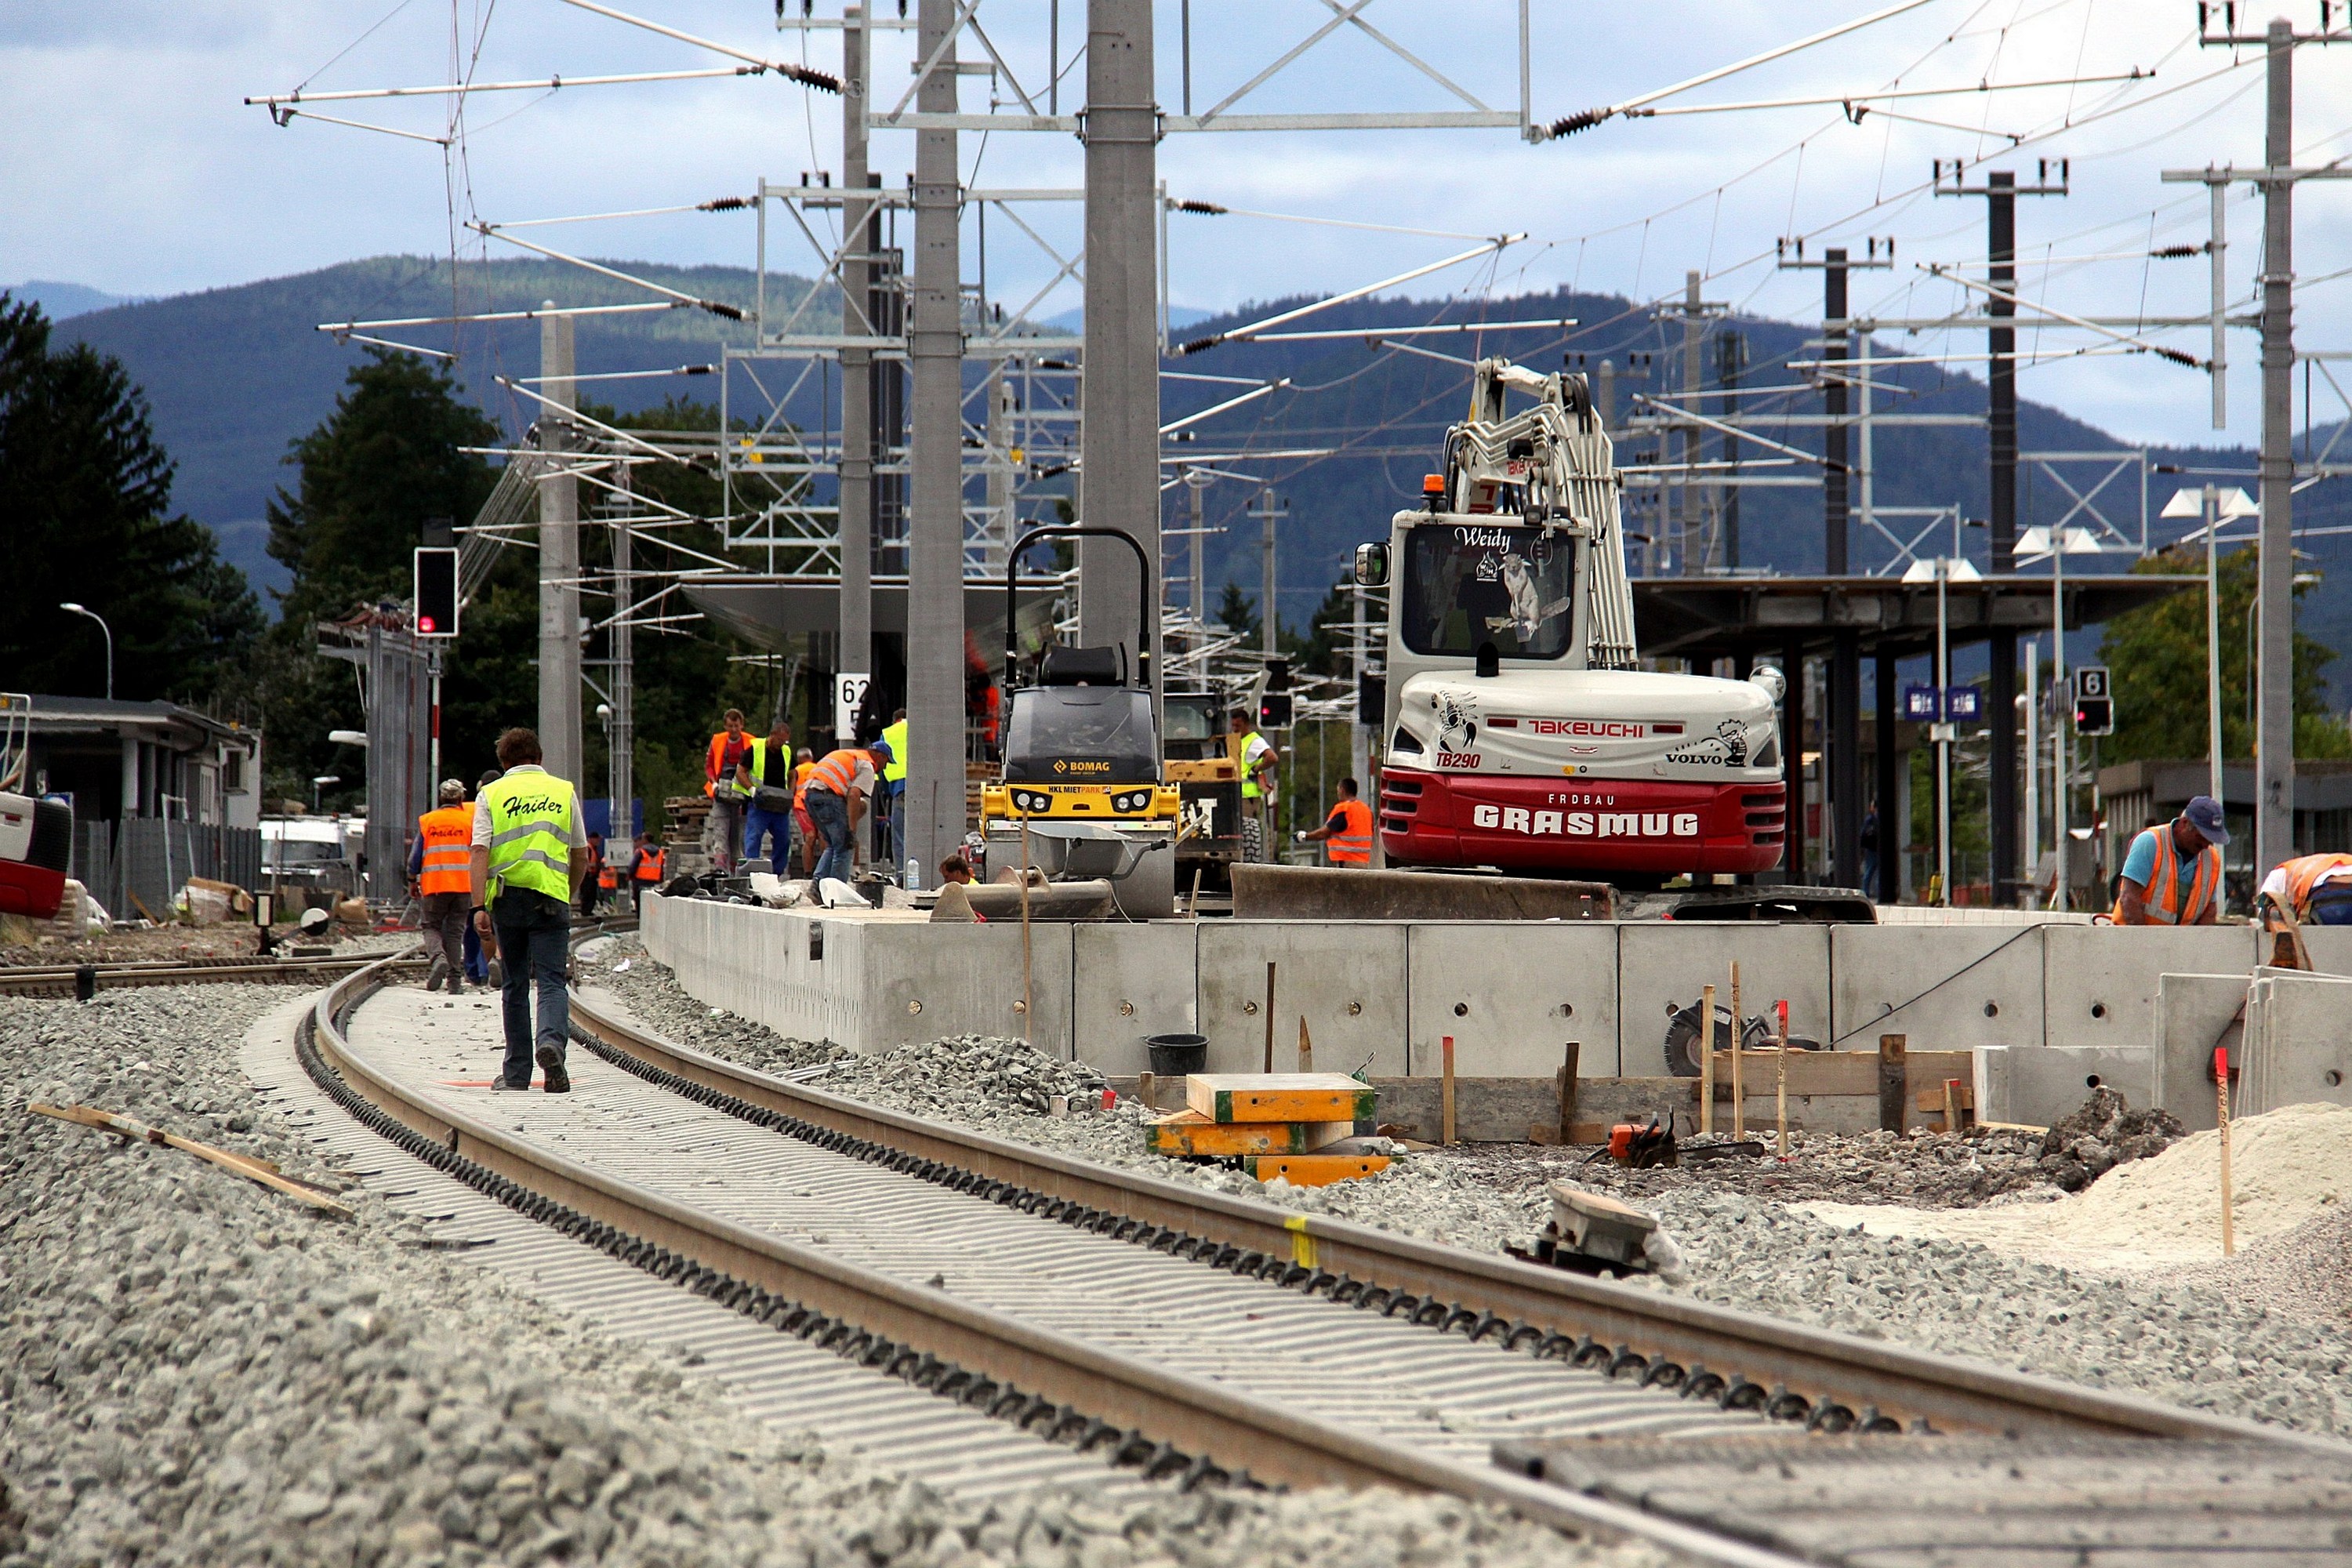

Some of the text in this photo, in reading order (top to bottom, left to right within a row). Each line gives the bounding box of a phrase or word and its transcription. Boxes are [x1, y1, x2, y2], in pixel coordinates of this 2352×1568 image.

[1454, 527, 1512, 554] Weidy
[2086, 673, 2100, 695] 6
[1070, 761, 1110, 771] BOMAG
[1436, 752, 1481, 768] TB290
[1666, 754, 1722, 765] VOLVO
[503, 796, 563, 818] Haider
[1473, 805, 1699, 838] GRASMUG
